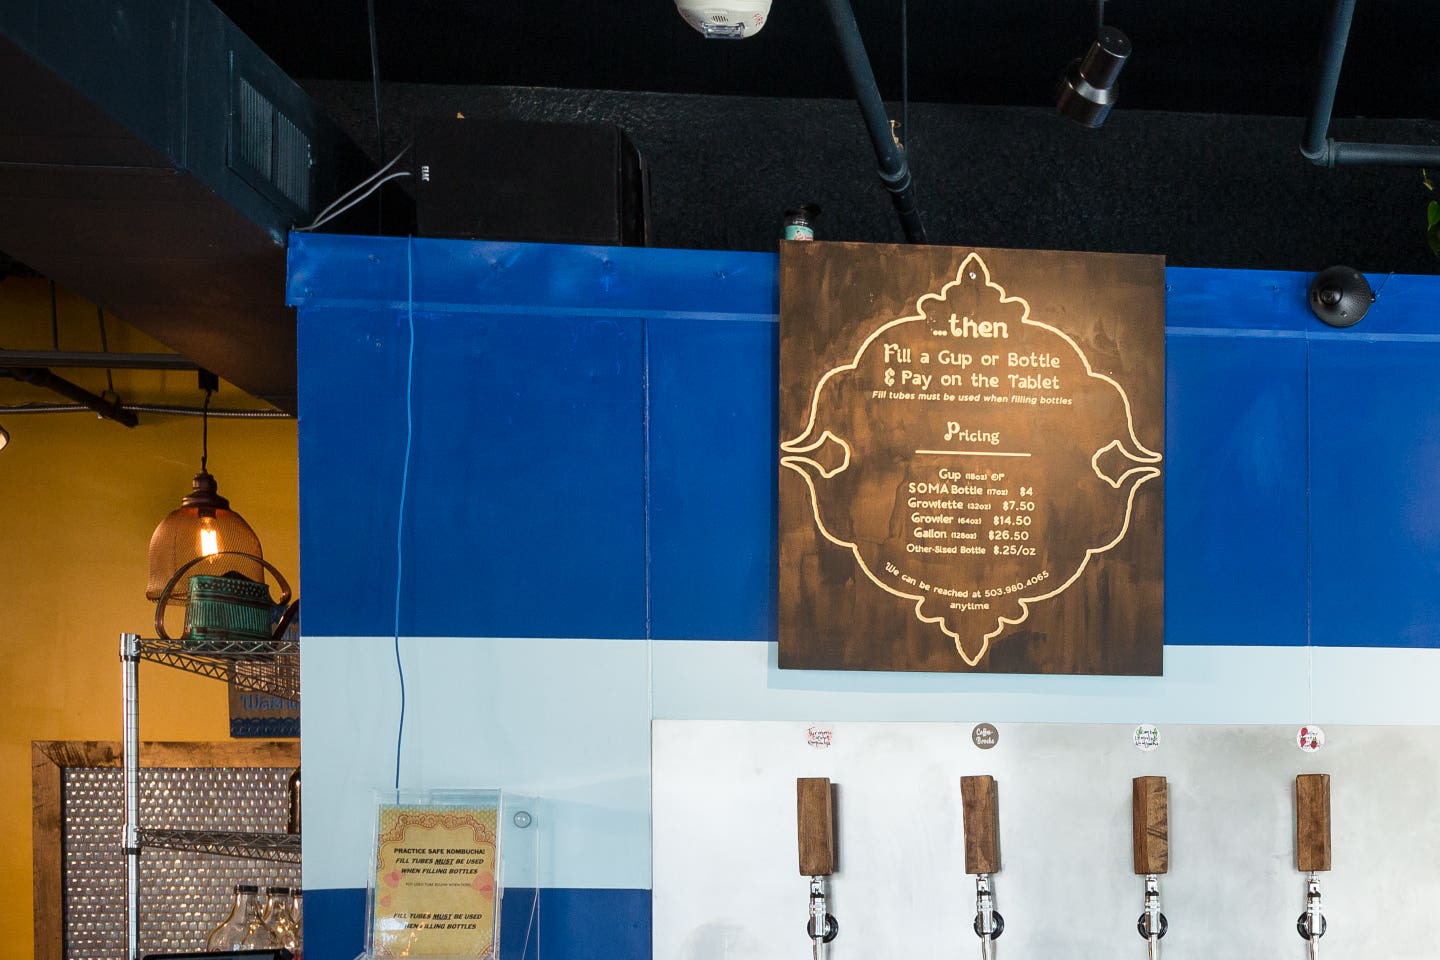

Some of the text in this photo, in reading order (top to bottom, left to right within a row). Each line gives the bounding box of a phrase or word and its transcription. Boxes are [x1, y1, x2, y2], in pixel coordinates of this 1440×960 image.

[884, 343, 911, 363] Fill
[920, 353, 930, 364] a
[981, 355, 999, 366] or
[1008, 352, 1060, 368] Bottle
[884, 368, 1060, 390] & Pay on the Tablet
[872, 390, 886, 399] Fill
[889, 392, 915, 400] tubes
[944, 393, 955, 402] be
[958, 394, 980, 402] used
[984, 394, 1008, 402] when
[1011, 394, 1037, 405] filling
[1040, 396, 1072, 405] bottles
[944, 421, 1000, 444] Pricing
[990, 473, 1005, 481] or
[908, 482, 1033, 496] SOMA Bottle (17oz) $4
[908, 497, 964, 509] Growlette
[1002, 501, 1035, 511] $7.50
[911, 512, 954, 524] Growler
[993, 516, 1032, 526] $14.50
[914, 527, 947, 538] Gallon
[988, 530, 1028, 540] $26.50
[906, 544, 1036, 556] Other-Sized Bottle $.25/oz
[886, 562, 1049, 598] We can be reached at 503.980.4065
[950, 602, 990, 612] anytime
